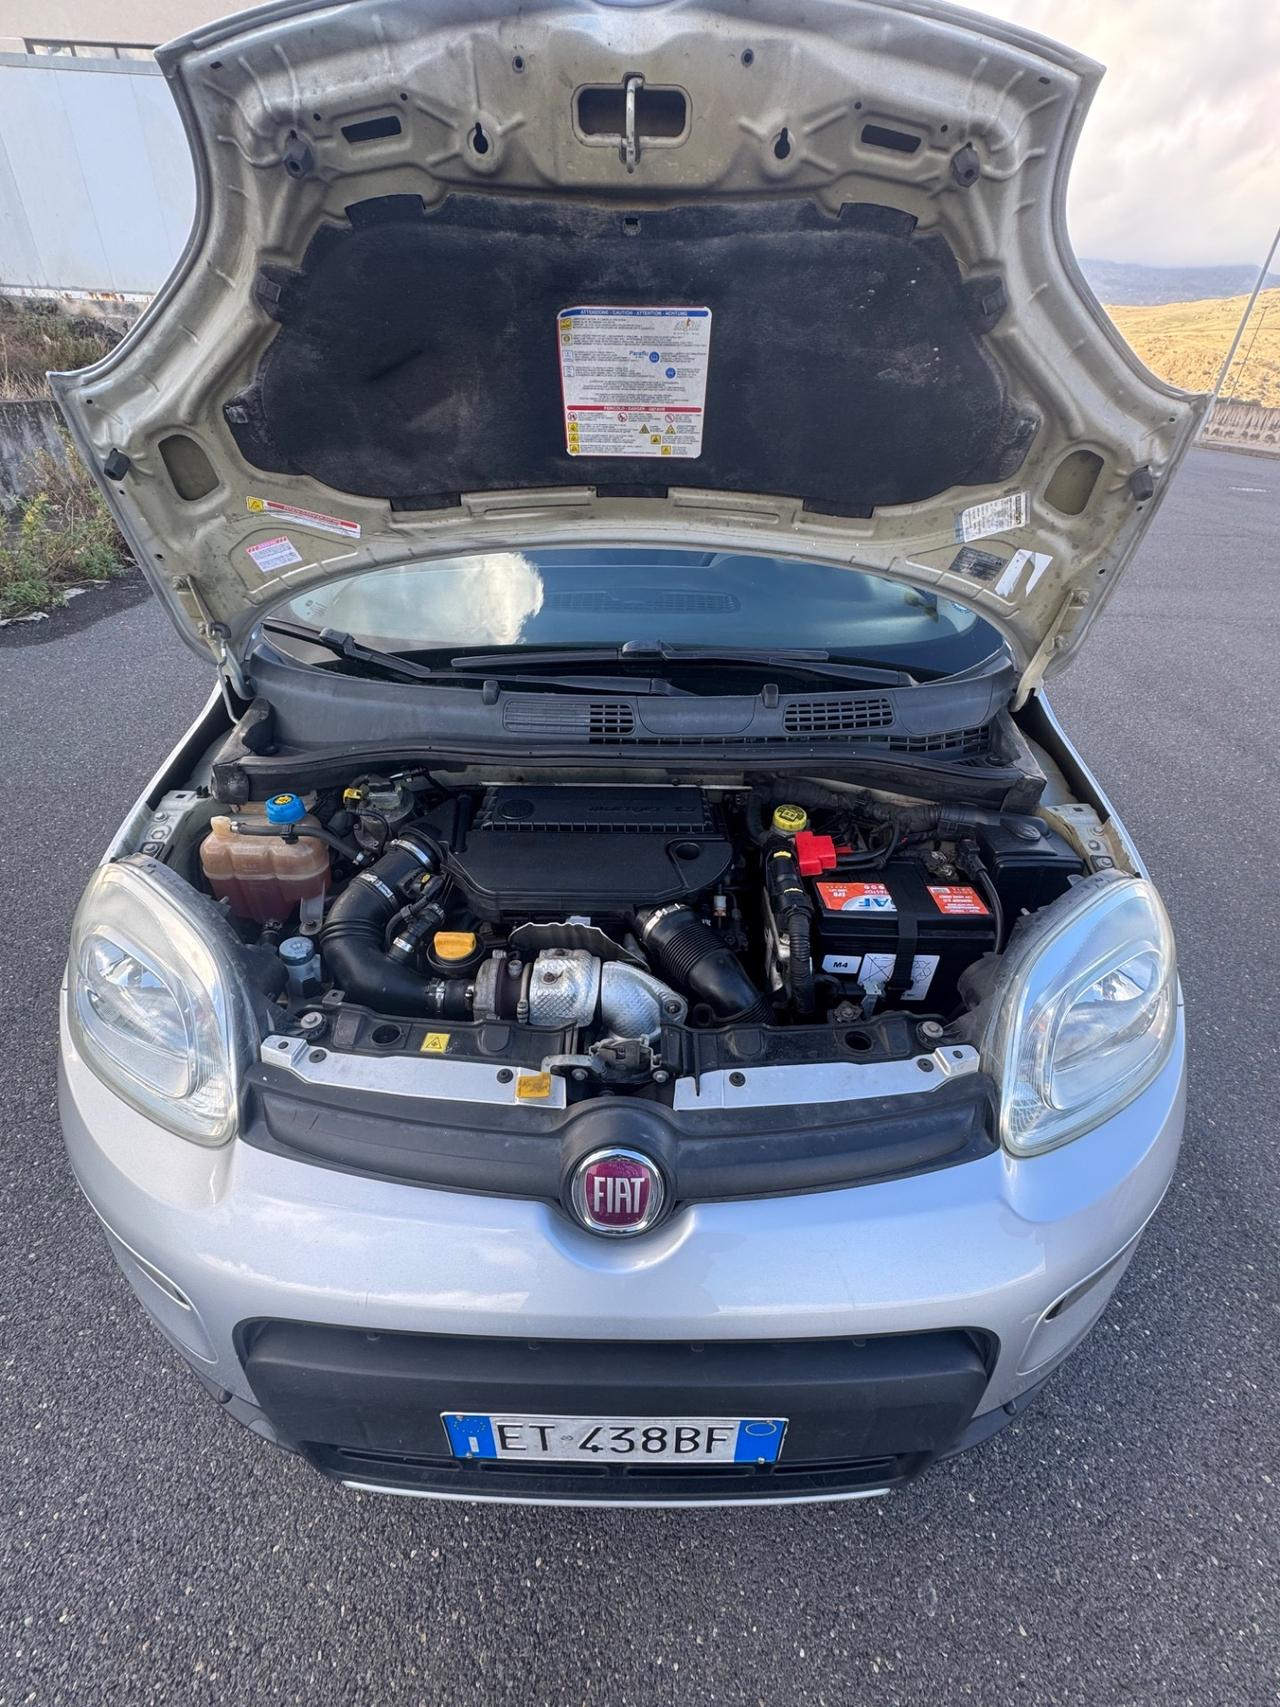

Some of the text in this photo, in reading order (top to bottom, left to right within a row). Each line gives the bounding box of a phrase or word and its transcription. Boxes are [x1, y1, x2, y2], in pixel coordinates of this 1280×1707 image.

[832, 960, 849, 968] M4
[593, 1176, 646, 1214] FIAT
[496, 1423, 735, 1454] ET 438BF
